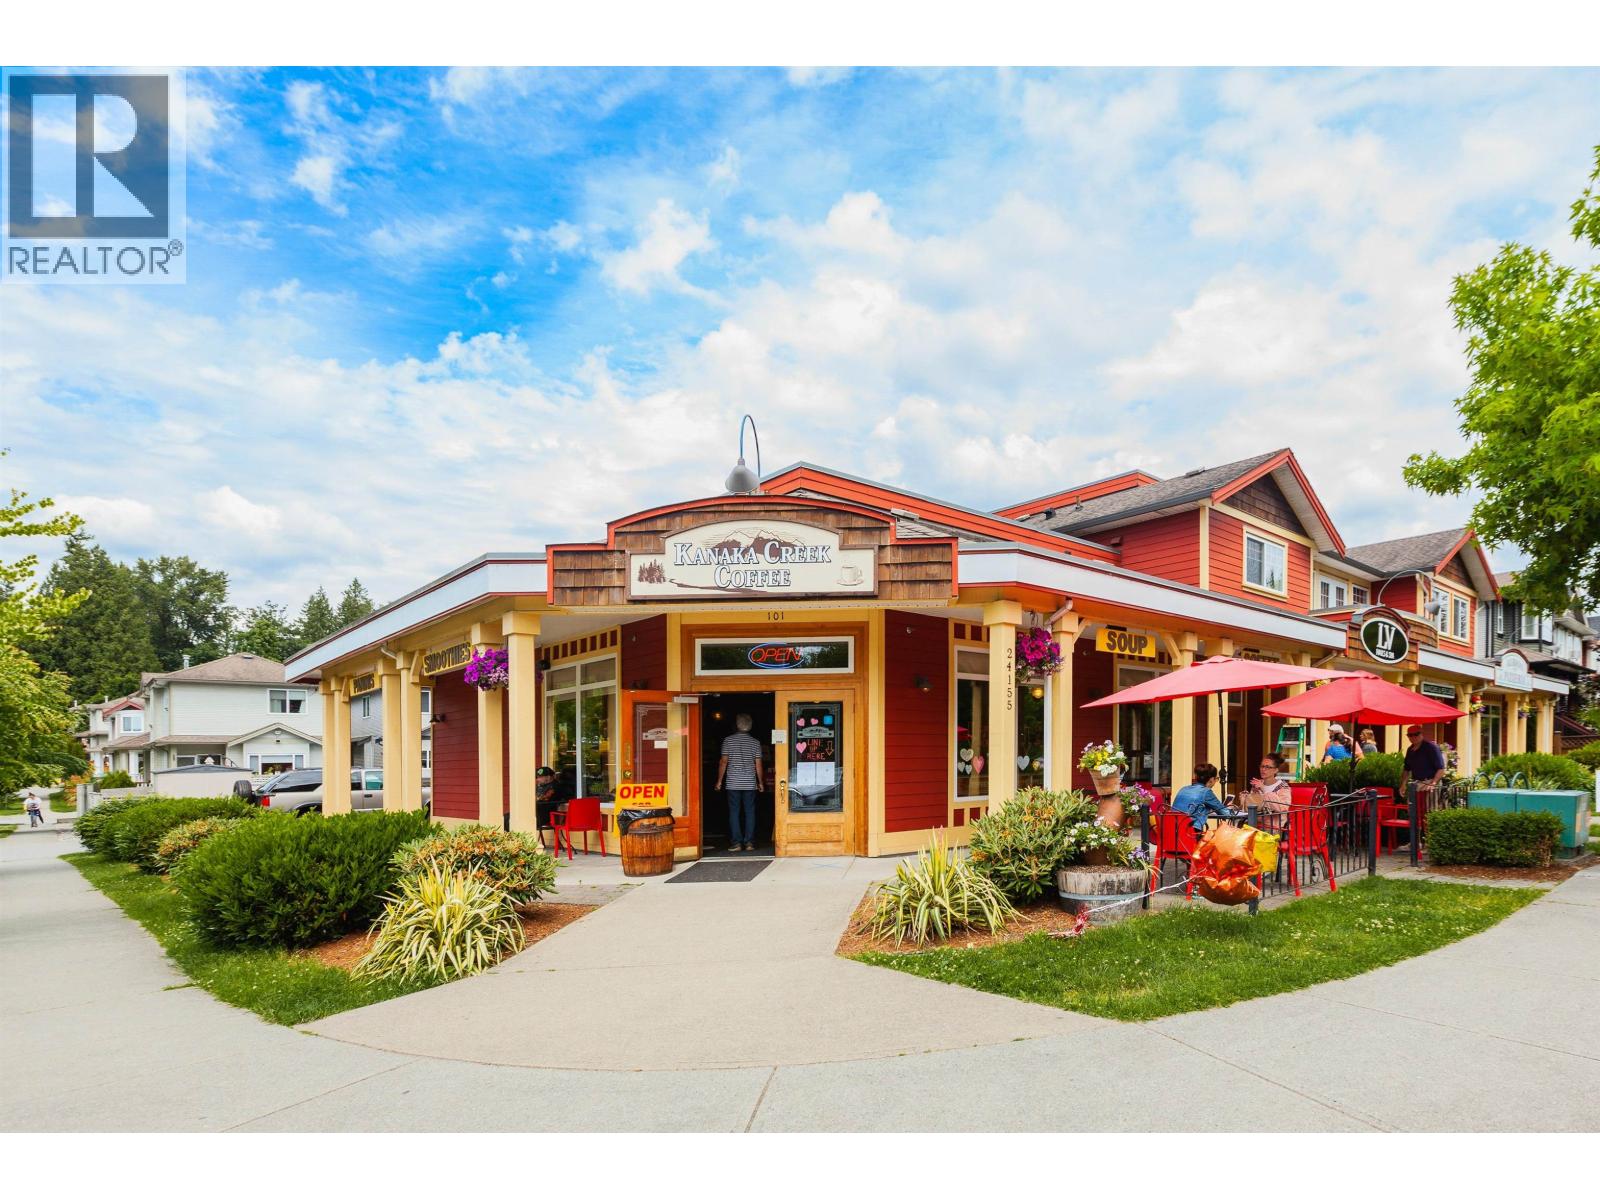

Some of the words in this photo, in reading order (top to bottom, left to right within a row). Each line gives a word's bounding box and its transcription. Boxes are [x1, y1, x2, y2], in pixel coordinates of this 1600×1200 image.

[673, 542, 758, 566] KANAKA
[763, 540, 832, 564] CREEK
[714, 565, 792, 588] COFFEE
[767, 611, 785, 621] 101
[750, 646, 802, 663] OPEN
[1105, 630, 1149, 655] SOUP
[423, 641, 472, 674] SMOOTHIES
[1006, 648, 1014, 711] 24155
[619, 785, 665, 799] OPEN
